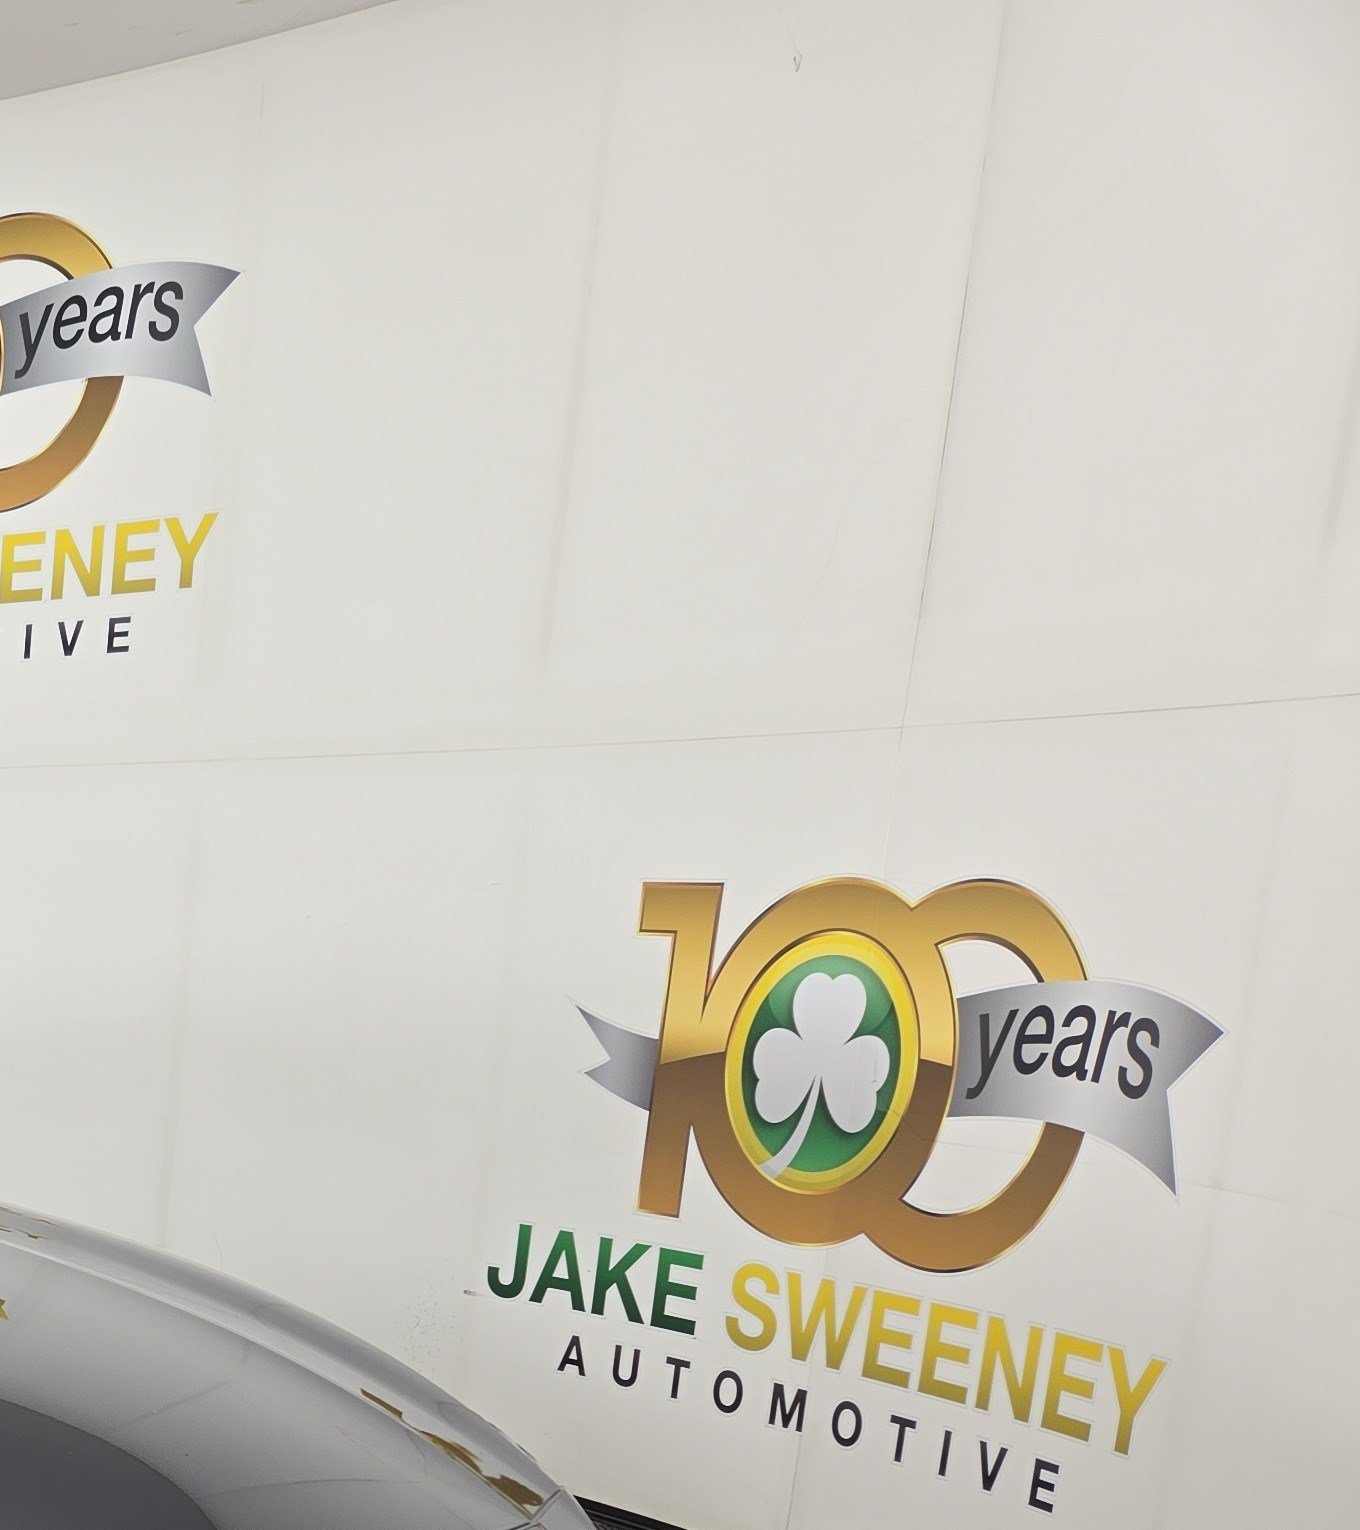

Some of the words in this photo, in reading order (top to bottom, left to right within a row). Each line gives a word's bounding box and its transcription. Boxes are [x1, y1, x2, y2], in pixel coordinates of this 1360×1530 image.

[15, 281, 183, 379] years
[965, 1004, 1160, 1100] years
[486, 1223, 705, 1335] JAKE
[724, 1263, 1169, 1456] SWEENEY
[557, 1334, 1060, 1513] AUTOMOTIVE
